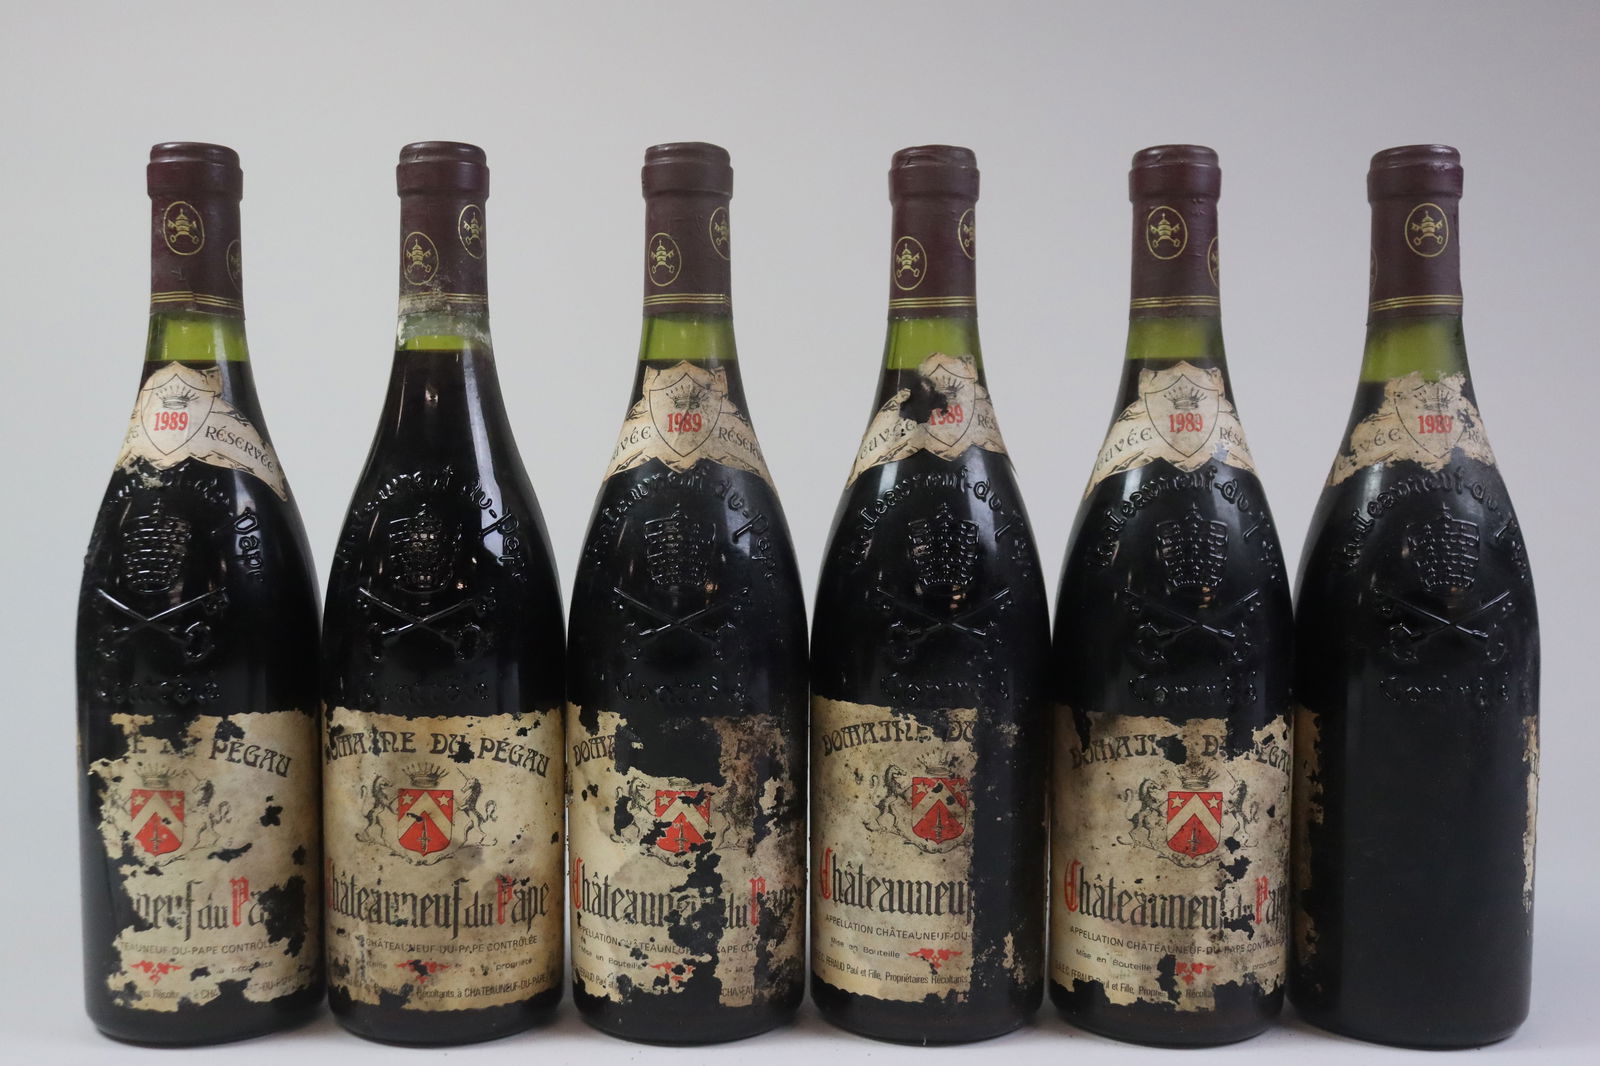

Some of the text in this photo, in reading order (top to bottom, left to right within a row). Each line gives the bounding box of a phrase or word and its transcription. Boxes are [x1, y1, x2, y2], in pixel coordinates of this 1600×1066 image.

[153, 411, 189, 431] 1989
[667, 412, 703, 433] 1989
[1169, 412, 1204, 433] 1989
[1417, 414, 1453, 434] 1989
[463, 891, 494, 929] du
[1069, 925, 1124, 947] APPELLATION
[1076, 948, 1092, 960] Mise
[1111, 982, 1118, 992] et
